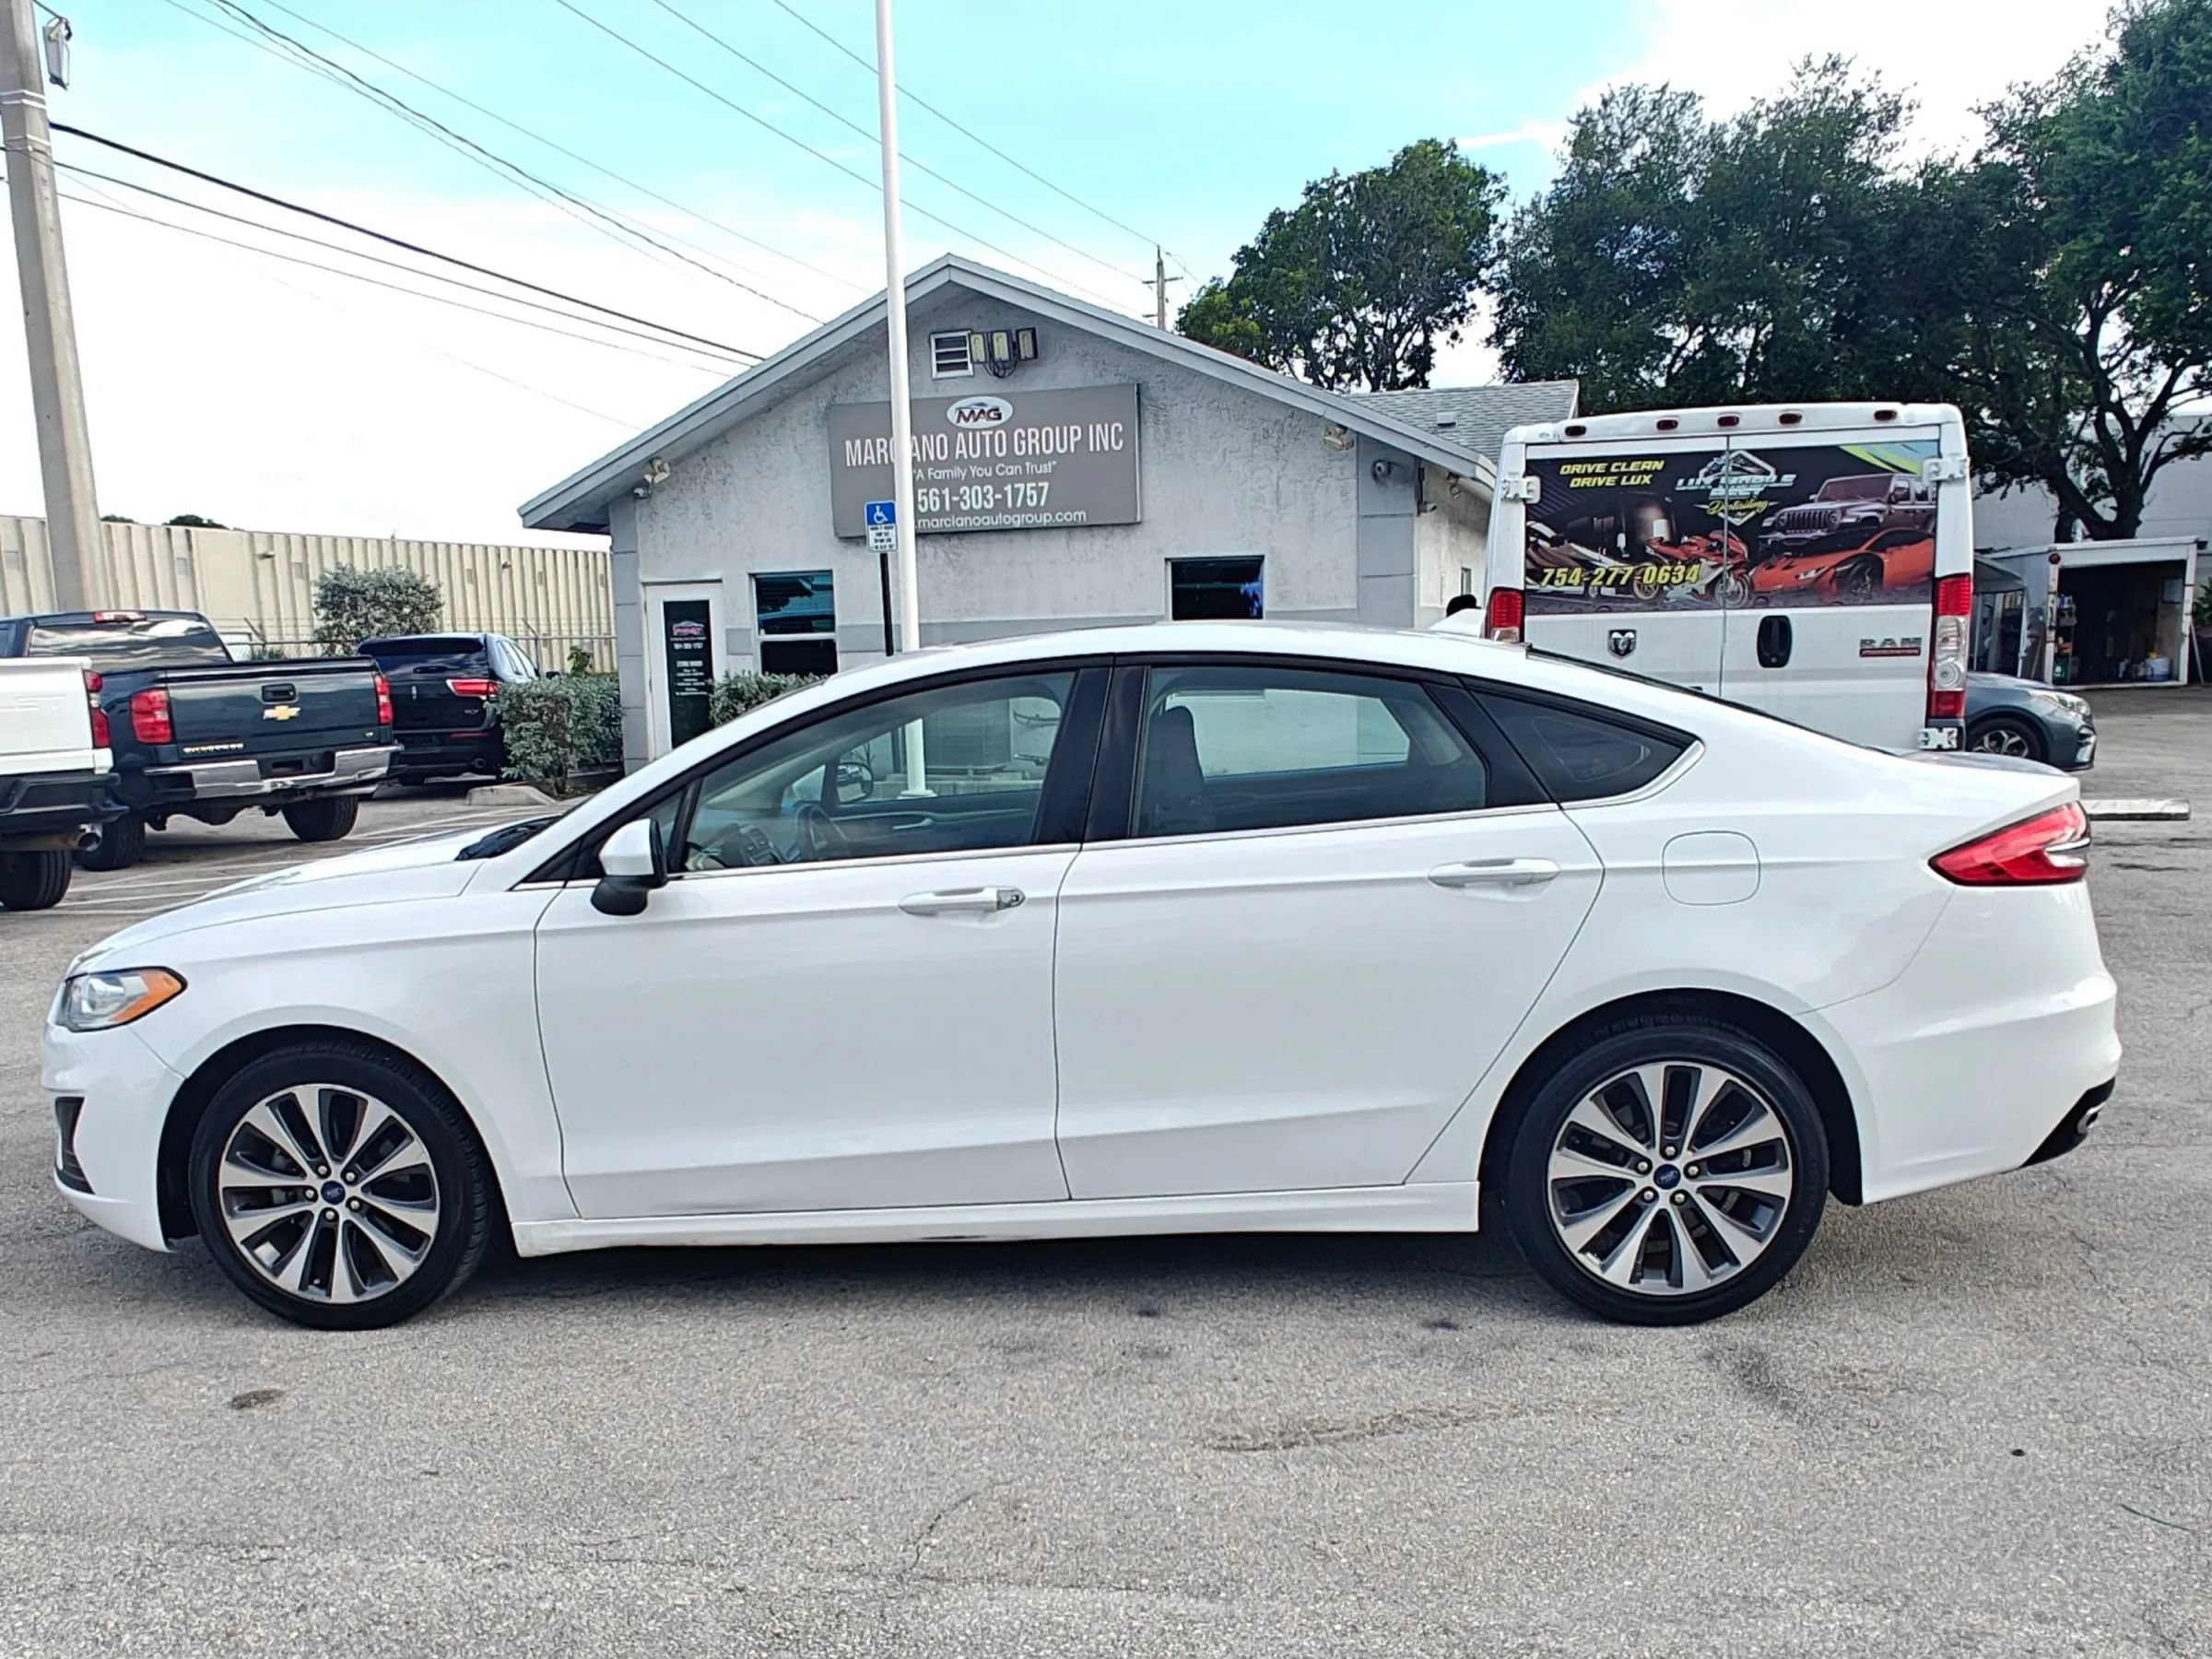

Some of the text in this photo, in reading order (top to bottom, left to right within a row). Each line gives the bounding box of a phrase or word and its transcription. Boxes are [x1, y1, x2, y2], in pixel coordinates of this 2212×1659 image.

[955, 406, 1002, 424] MAG
[955, 429, 1007, 460] AUTO
[1014, 425, 1082, 456] GROUP
[1088, 422, 1124, 453] INC
[927, 465, 968, 481] Family
[970, 465, 993, 478] You
[995, 463, 1022, 477] Can
[1559, 460, 1665, 476] DRIVE CLEAN
[1569, 474, 1653, 488] DRIVE LUX
[917, 481, 1050, 513] 561-303-1757
[1540, 563, 1701, 588] 754-277-0634
